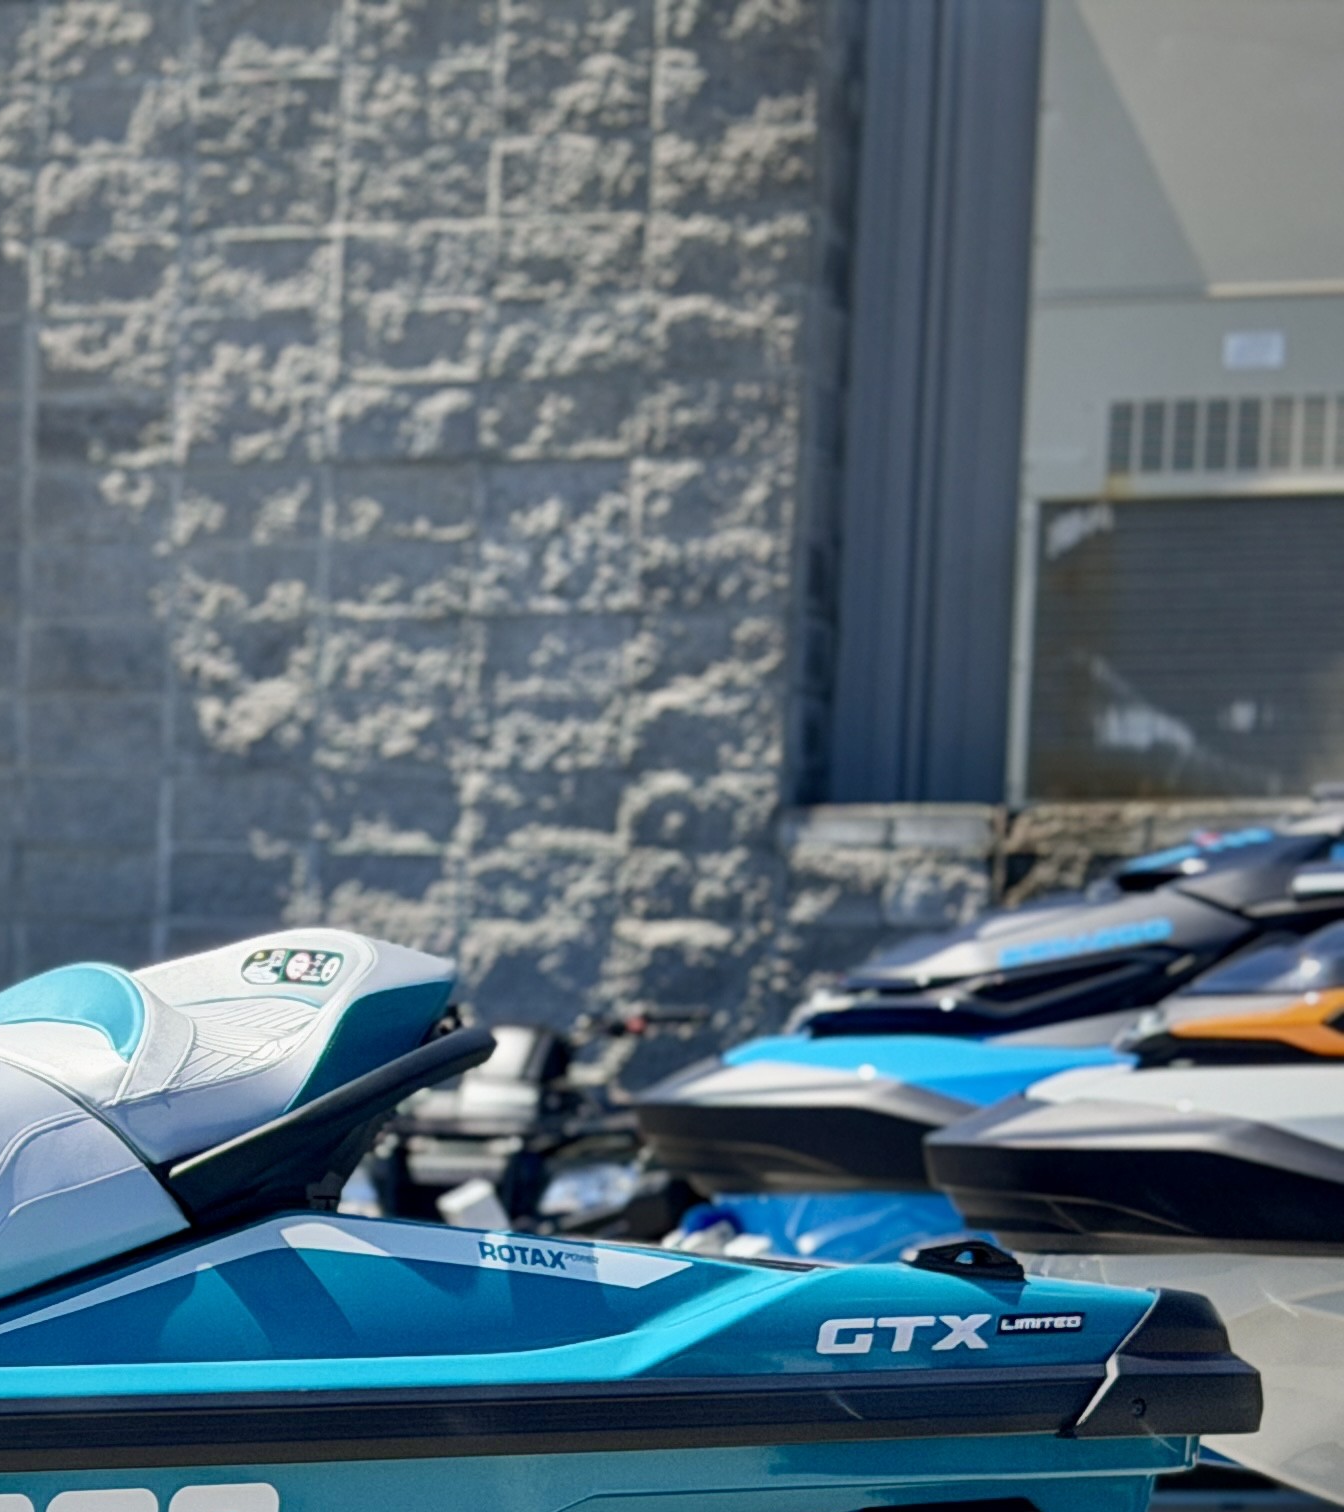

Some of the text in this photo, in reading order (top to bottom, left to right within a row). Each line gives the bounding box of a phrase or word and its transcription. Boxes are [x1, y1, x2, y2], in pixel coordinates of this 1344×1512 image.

[478, 1241, 566, 1270] ROTAX
[816, 1313, 1082, 1354] GTX LIMITED
